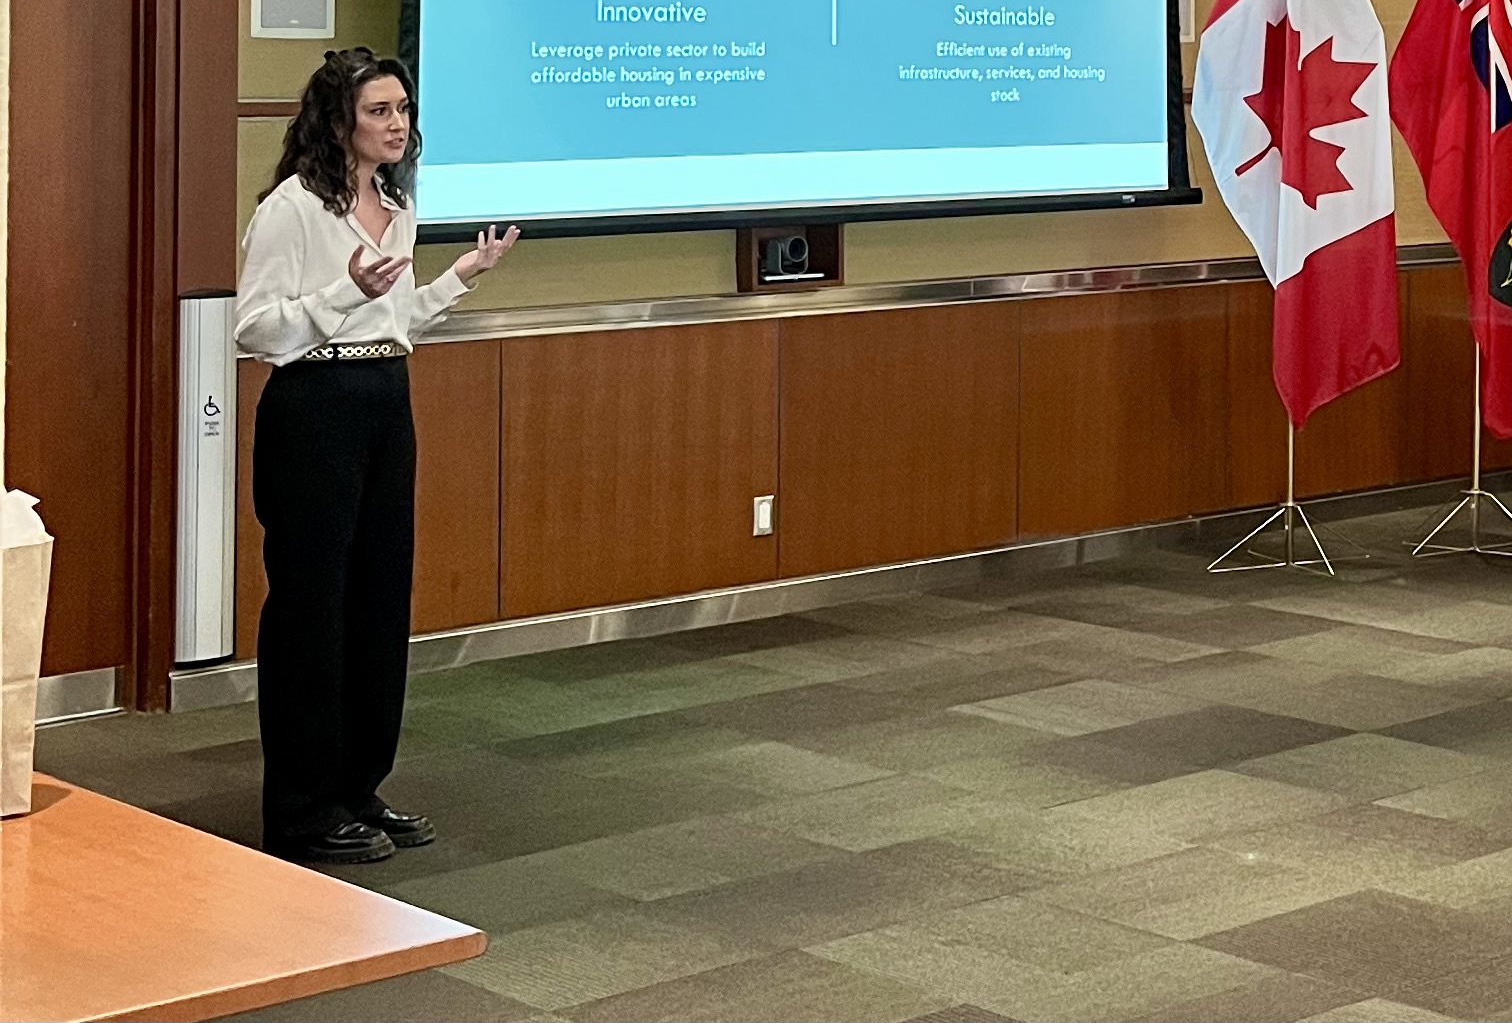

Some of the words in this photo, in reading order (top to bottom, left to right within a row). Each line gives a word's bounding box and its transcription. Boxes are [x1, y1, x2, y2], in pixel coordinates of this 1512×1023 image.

[597, 0, 707, 23] Innovative
[954, 4, 1055, 26] Sustainable
[531, 41, 604, 60] Leverage
[608, 41, 662, 60] private
[666, 43, 708, 57] sector
[712, 43, 727, 57] to
[731, 40, 766, 57] build
[936, 41, 985, 57] Efficient
[987, 44, 1008, 57] use
[1011, 41, 1024, 57] of
[1027, 43, 1072, 60] existing
[531, 66, 616, 83] affordable
[620, 66, 674, 85] housing
[679, 66, 692, 81] in
[695, 66, 766, 84] expensive
[899, 65, 983, 82] infrastructure,
[986, 65, 1035, 82] services,
[1038, 65, 1060, 79] and
[1063, 65, 1105, 82] housing
[606, 92, 650, 108] urban
[654, 95, 697, 107] areas
[991, 88, 1020, 102] stock
